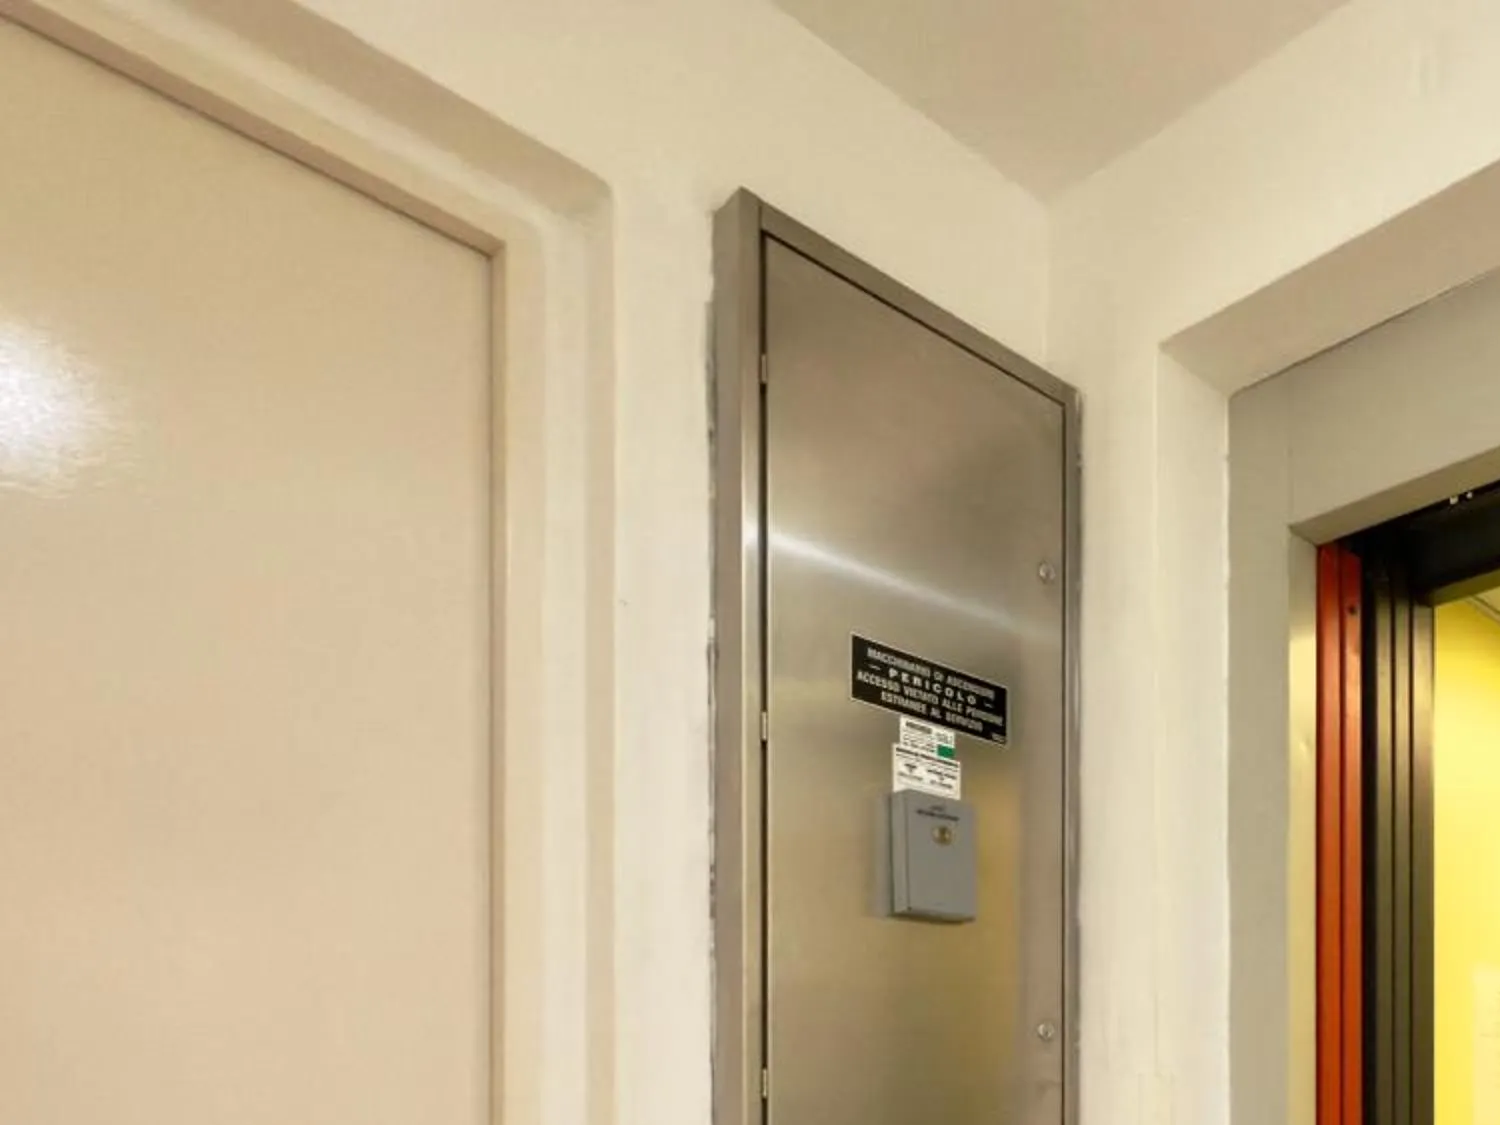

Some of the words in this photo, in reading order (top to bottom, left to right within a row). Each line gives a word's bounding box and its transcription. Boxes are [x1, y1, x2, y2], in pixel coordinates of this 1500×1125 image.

[857, 670, 901, 693] ACCESSO
[903, 685, 939, 705] VIETATO
[941, 698, 963, 714] ALLE
[888, 668, 977, 705] PERICOLO
[930, 707, 942, 719] AL
